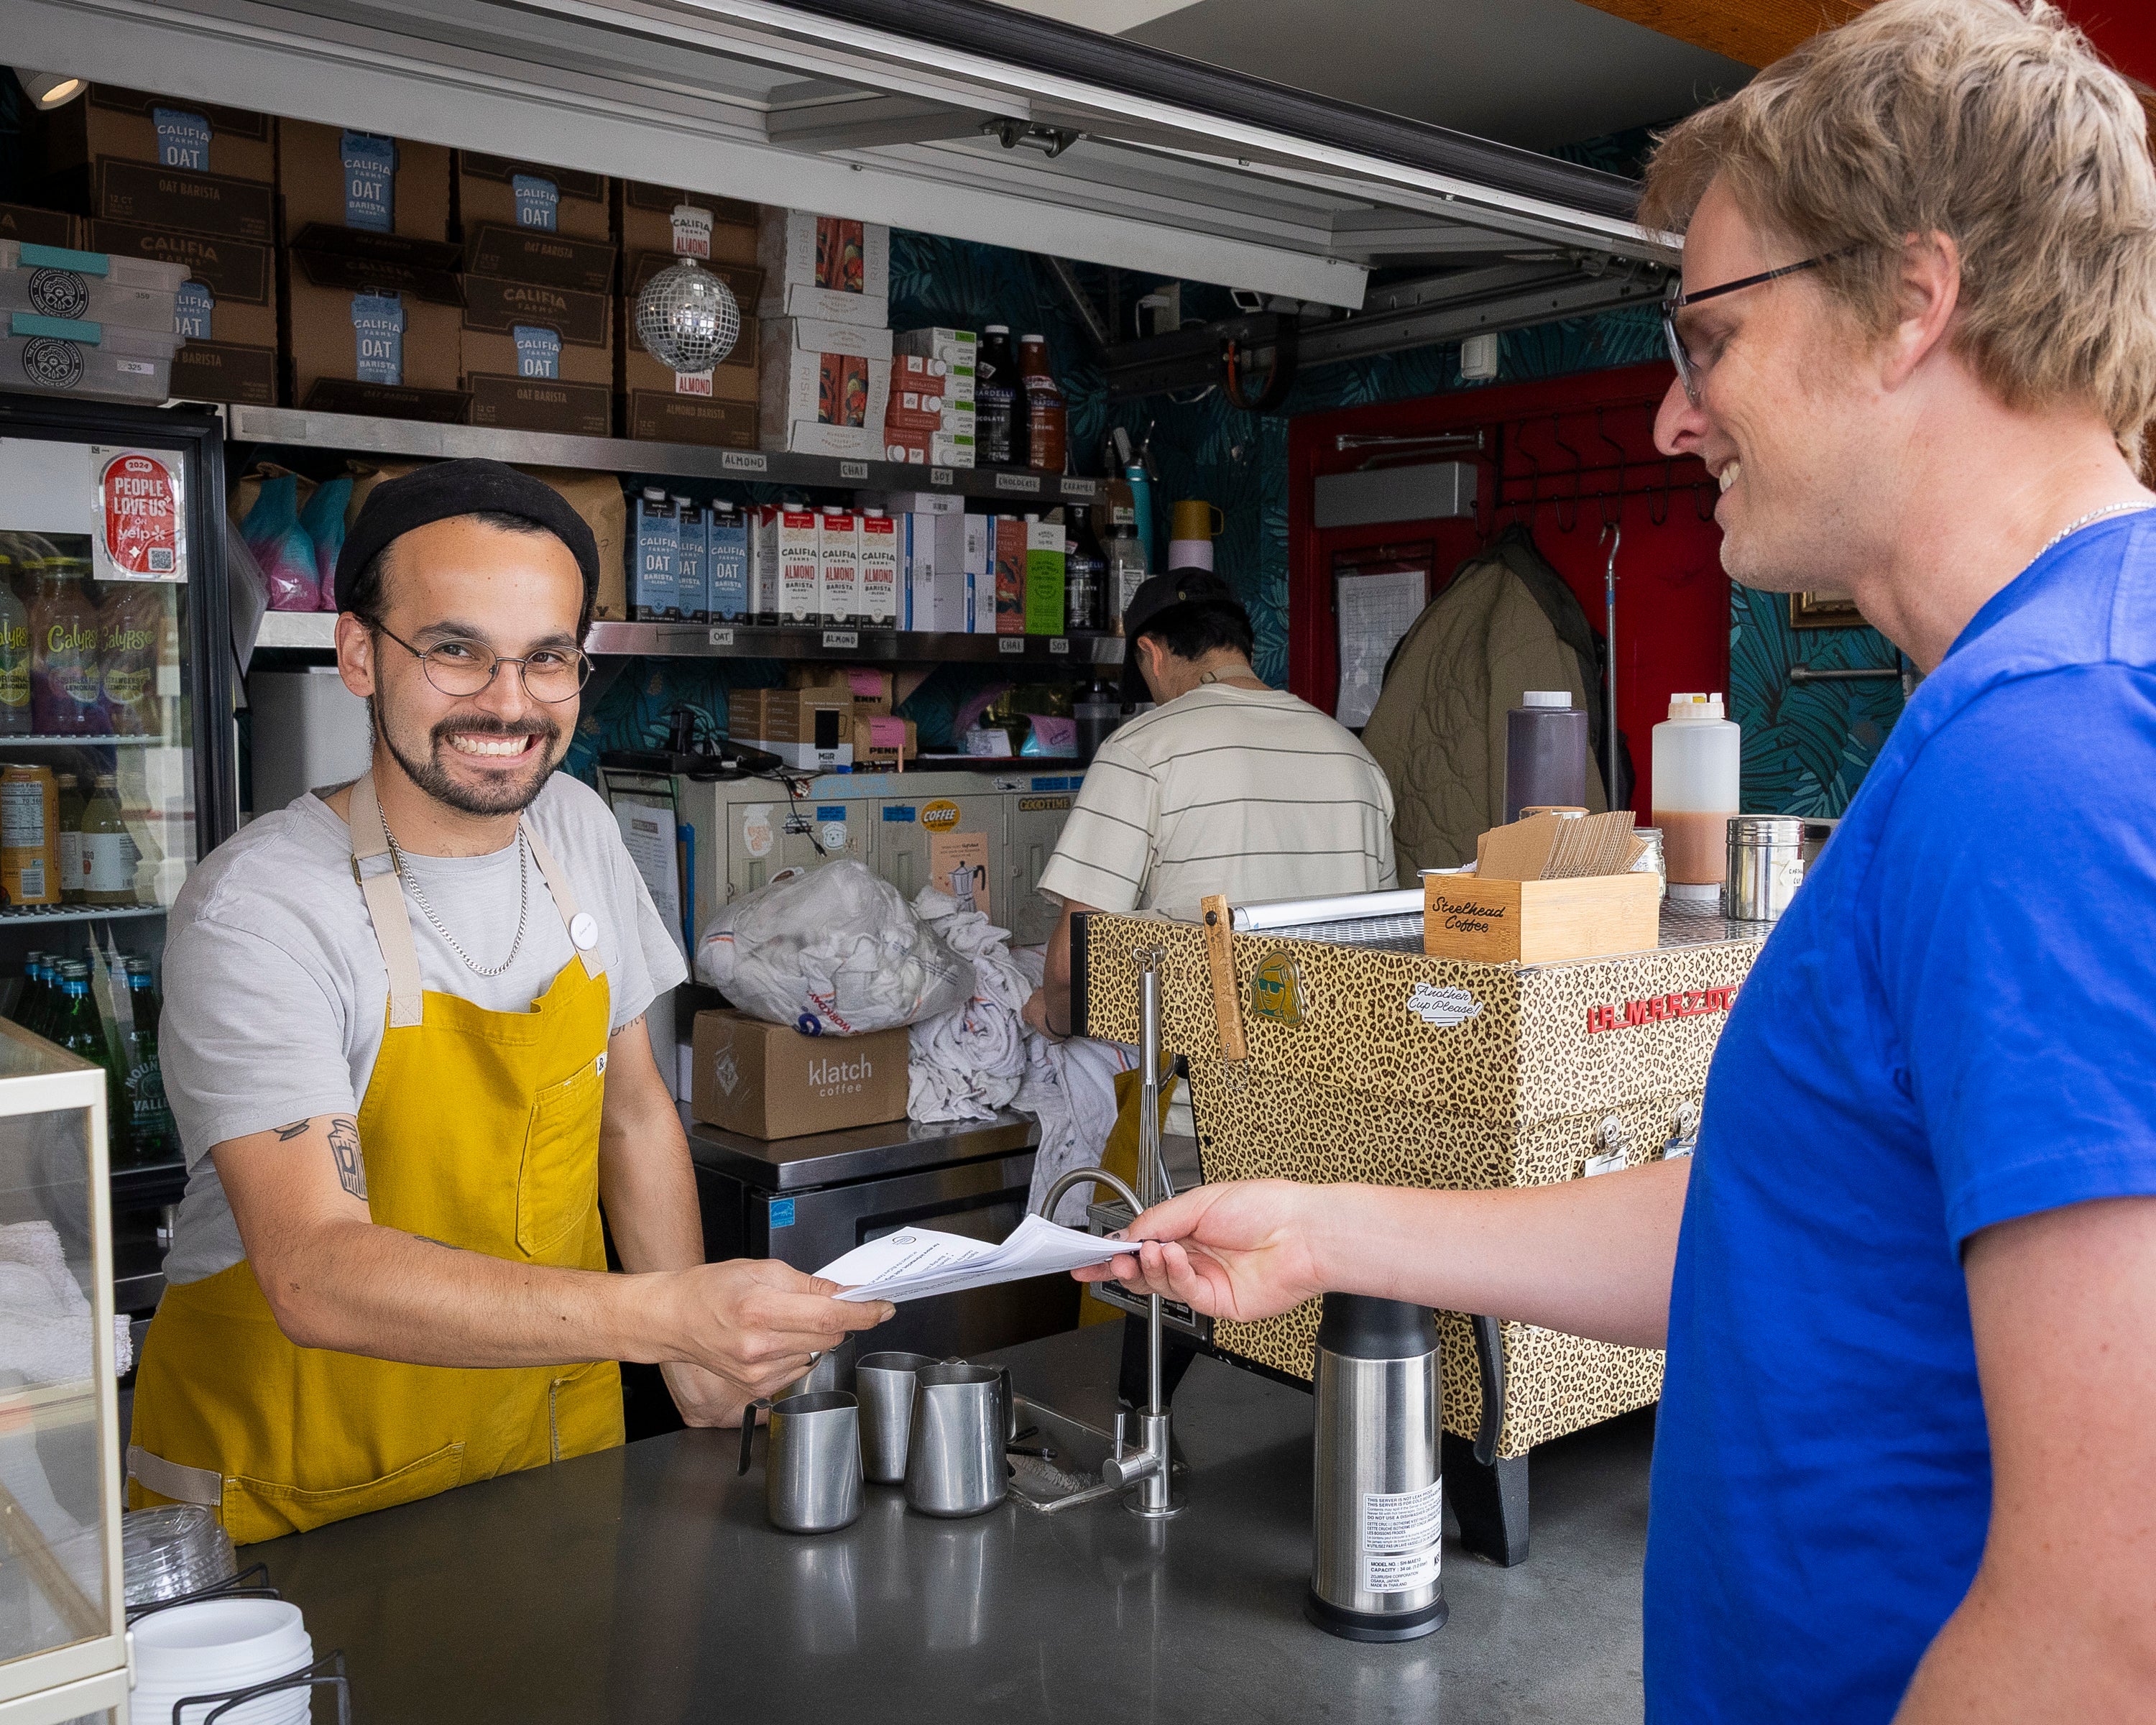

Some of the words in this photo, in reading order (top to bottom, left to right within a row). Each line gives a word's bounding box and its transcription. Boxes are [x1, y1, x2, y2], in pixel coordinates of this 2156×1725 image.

[157, 125, 209, 142] CALIFIA
[167, 146, 200, 169] OAT
[345, 160, 391, 175] CALIFIA
[160, 179, 178, 193] OAT
[180, 183, 220, 200] BARISTA
[352, 180, 382, 201] OAT
[515, 188, 558, 203] CALIFIA
[349, 201, 386, 213] BARISTA
[523, 208, 550, 226] OAT
[673, 218, 709, 232] CALIFIA
[140, 236, 218, 263] CALIFIA
[676, 236, 708, 257] ALMOND
[136, 292, 150, 300] 359
[504, 288, 567, 310] CALIFIA
[354, 319, 400, 333] CALIFIA
[362, 339, 392, 358] OAT
[517, 340, 559, 352] CALIFIA
[183, 352, 222, 367] BARISTA
[360, 361, 396, 370] BARISTA
[127, 363, 142, 372] 325
[525, 359, 551, 377] OAT
[679, 377, 710, 395] ALMOND
[799, 367, 809, 408] RISHI
[517, 389, 532, 400] OAT
[535, 390, 566, 402] BARISTA
[697, 407, 725, 419] BARISTA
[724, 454, 764, 468] ALMOND
[842, 464, 865, 475] CHAI
[934, 472, 949, 482] SOY
[115, 477, 164, 497] PEOPLE
[998, 476, 1036, 487] CHOCOLATE
[1064, 482, 1093, 492] CARAMEL
[114, 497, 147, 516] LOVE
[149, 499, 166, 516] US
[119, 527, 151, 541] yelp
[640, 537, 678, 548] CALIFIA
[711, 547, 745, 557] CALIFIA
[782, 548, 816, 557] CALIFIA
[822, 551, 856, 559] CALIFIA
[862, 553, 895, 561] CALIFIA
[647, 555, 671, 571] OAT
[717, 563, 739, 579] OAT
[785, 565, 815, 580] ALMOND
[825, 567, 854, 581] ALMOND
[864, 569, 893, 584] ALMOND
[826, 635, 855, 644] ALMOND
[1002, 640, 1021, 650] CHAI
[1021, 799, 1045, 810] GOOD
[1046, 798, 1069, 809] TIME
[923, 809, 957, 822] COFFEE
[1432, 896, 1506, 918] Steelhead
[1445, 915, 1488, 933] Coffee
[1417, 985, 1469, 1000] Another
[808, 993, 851, 1032] WORKDAY
[1409, 998, 1431, 1011] Cup
[1432, 1000, 1480, 1014] Please!
[1588, 1004, 1614, 1034] LA
[809, 1053, 872, 1086] klatch
[819, 1083, 862, 1098] coffee
